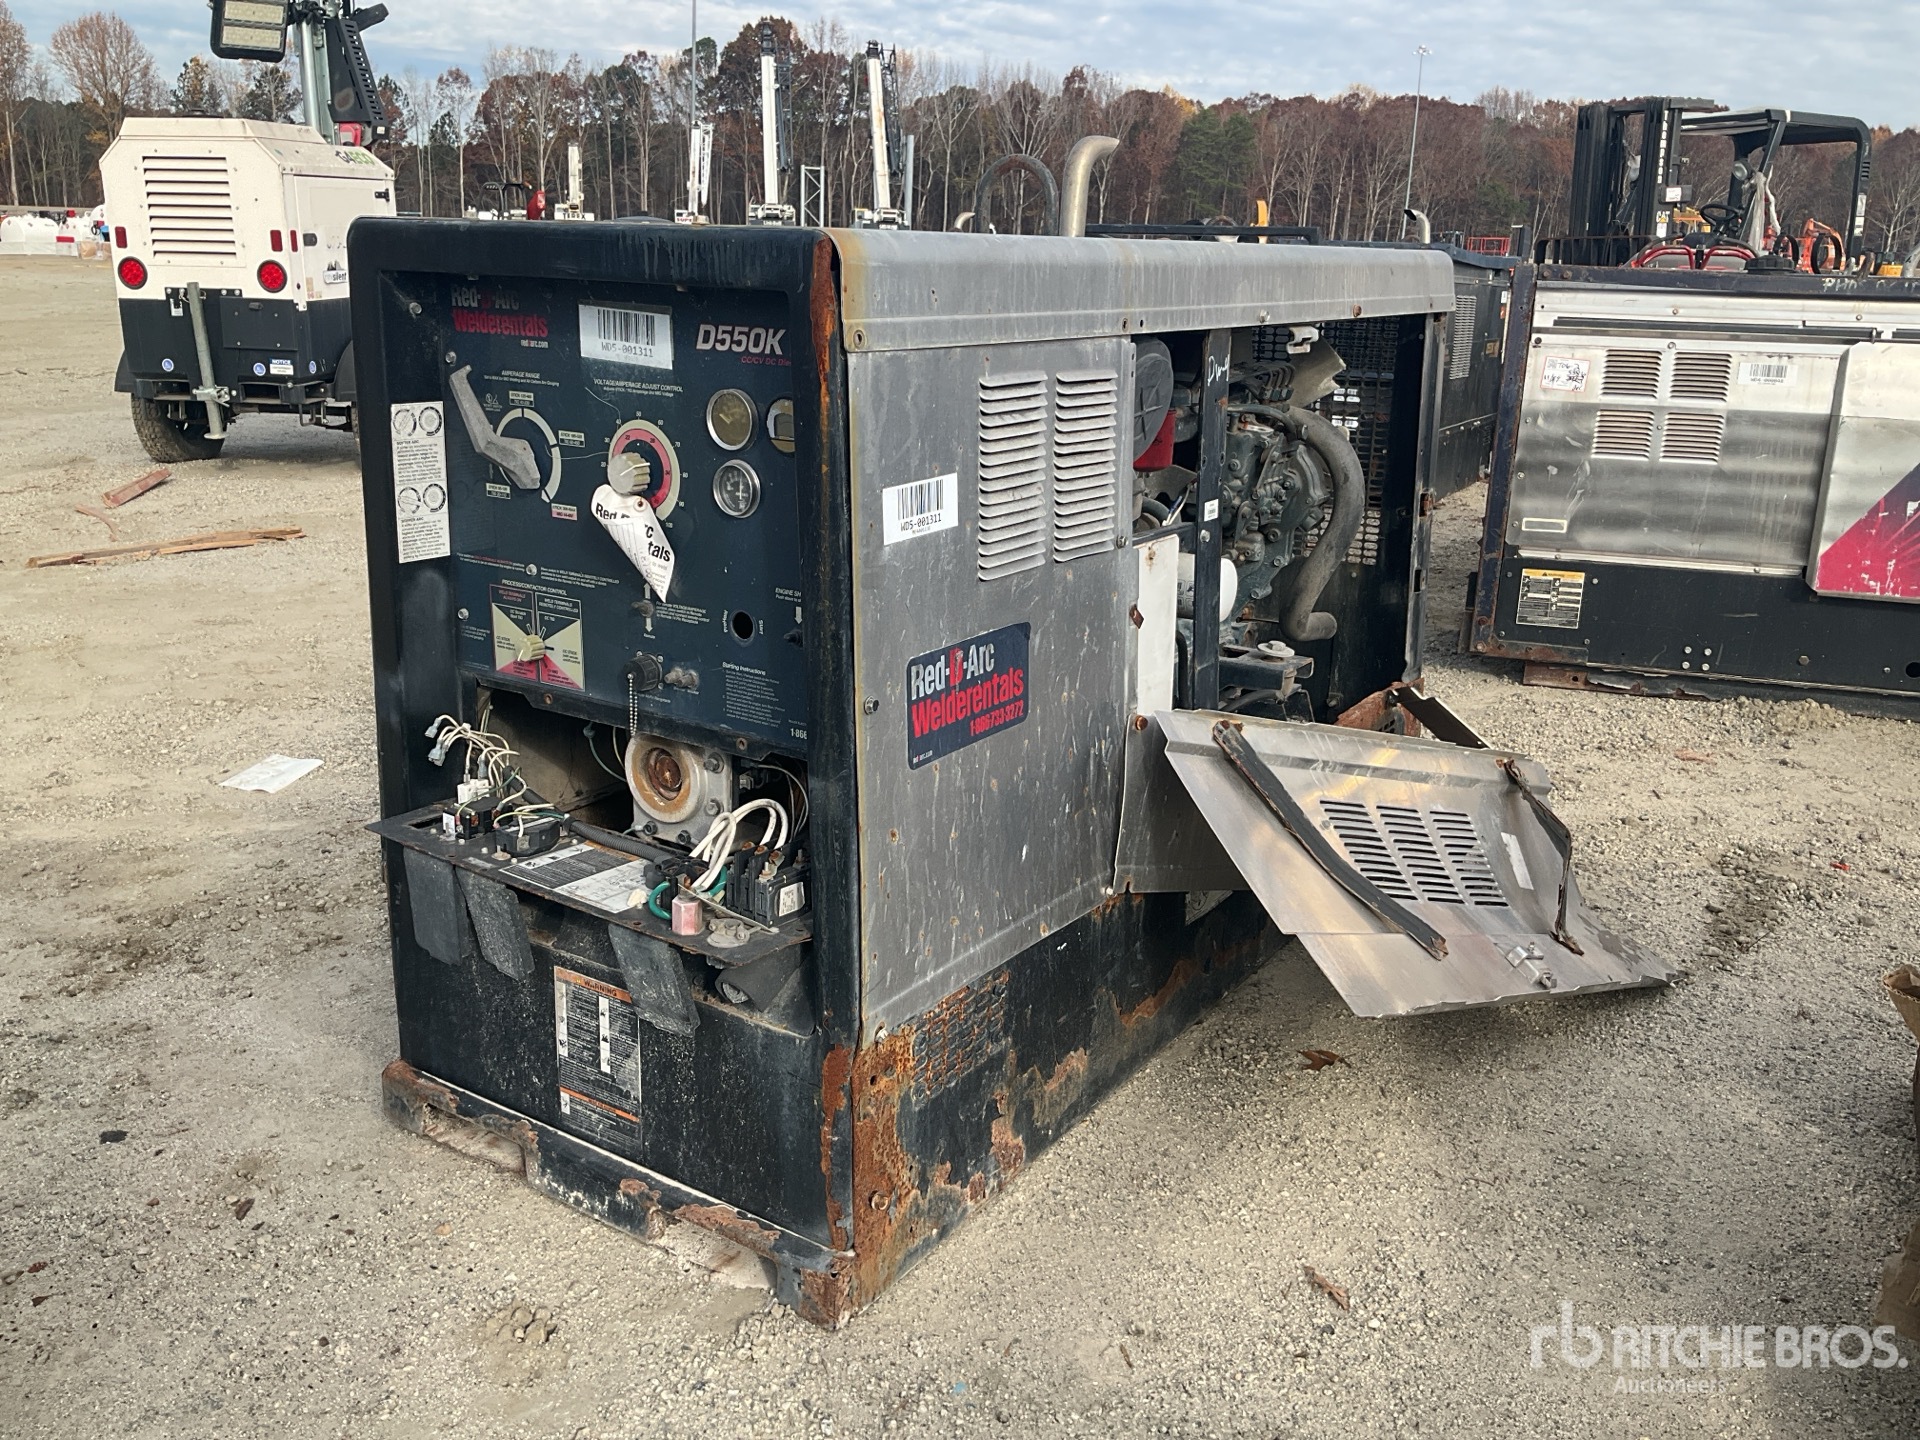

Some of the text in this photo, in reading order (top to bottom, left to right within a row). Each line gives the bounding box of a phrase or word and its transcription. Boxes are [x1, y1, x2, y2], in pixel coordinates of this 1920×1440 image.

[1656, 210, 1670, 223] CAT
[452, 308, 549, 338] Welderentals
[696, 323, 787, 356] D550K
[660, 384, 683, 392] CONTROL
[775, 587, 793, 596] ENGINE
[722, 661, 766, 676] Starting Instructions
[910, 643, 995, 700] Red-D-Arc
[911, 666, 1025, 739] Welderentals
